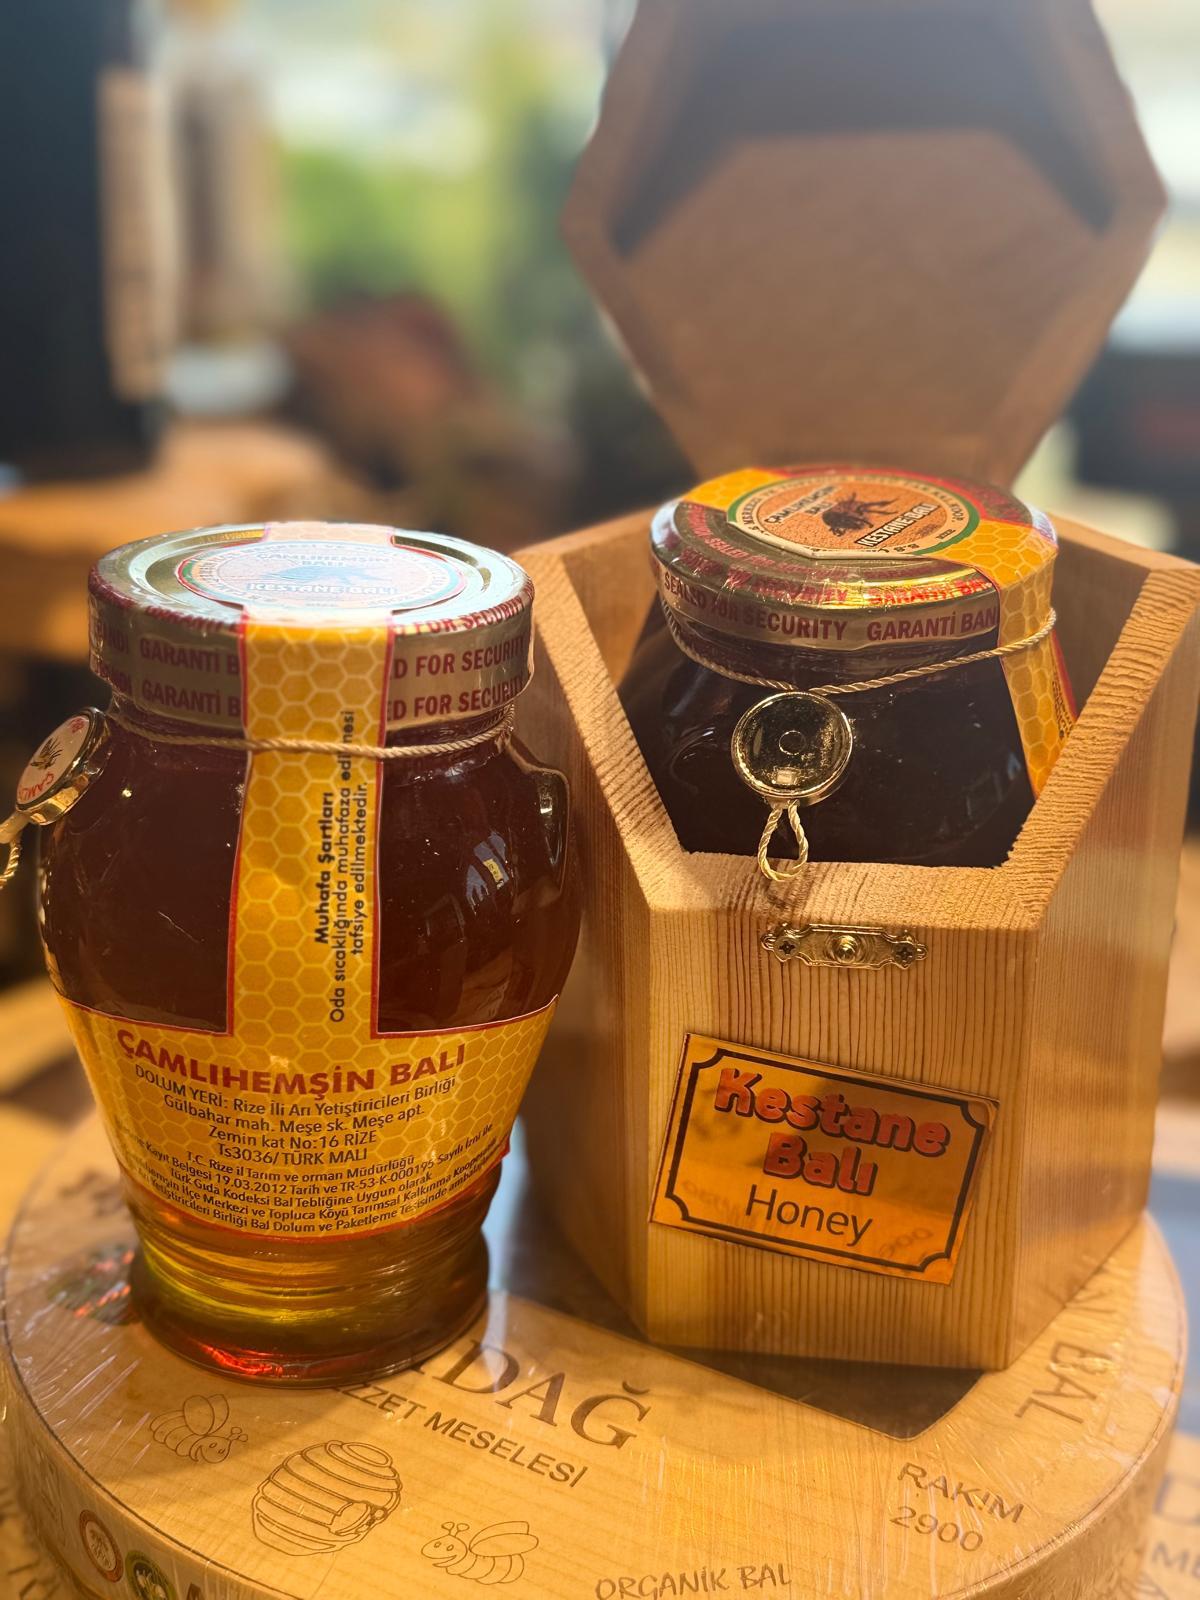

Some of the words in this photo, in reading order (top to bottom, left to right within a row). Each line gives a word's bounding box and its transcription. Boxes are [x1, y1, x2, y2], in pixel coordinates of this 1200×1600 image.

[856, 514, 906, 547] KESTANE
[904, 502, 938, 524] BALI
[249, 582, 344, 595] KESTANE
[743, 605, 848, 642] SECURITY
[866, 610, 957, 641] GARANTİ
[139, 637, 221, 674] GARANTİ
[227, 653, 240, 676] B
[415, 652, 456, 678] FOR
[141, 679, 222, 716] GARANTİ
[227, 695, 240, 718] B
[413, 693, 453, 718] FOR
[317, 792, 335, 865] Şartları
[334, 787, 352, 874] muhafaza
[350, 782, 368, 894] edilmektedir.
[314, 871, 331, 945] Muhafa
[348, 900, 368, 955] tafsiye
[331, 880, 350, 982] sıcaklığında
[329, 987, 345, 1023] Oda
[116, 1029, 375, 1101] ÇAMLIHEMŞİN
[390, 1043, 466, 1087] BALI
[135, 1064, 187, 1097] DOLUM
[189, 1085, 228, 1109] YERİ:
[233, 1098, 266, 1115] Rize
[289, 1103, 311, 1116] Arı
[315, 1090, 410, 1117] Yetiştiricileri
[414, 1075, 457, 1101] Birliği
[163, 1093, 232, 1126] Gülbahar
[235, 1117, 275, 1132] mah.
[279, 1119, 323, 1136] Meşe
[326, 1117, 349, 1132] sk.
[352, 1113, 394, 1129] Meşe
[397, 1103, 425, 1122] apt.
[713, 1066, 951, 1158] Kestane
[208, 1124, 257, 1146] Zemin
[261, 1134, 286, 1149] kat
[289, 1135, 339, 1150] No:16
[344, 1129, 378, 1147] RİZE
[329, 1147, 368, 1165] MALI
[172, 1156, 212, 1181] Belgesi
[215, 1173, 287, 1195] 19.03.2012
[289, 1184, 320, 1195] Tarih
[323, 1183, 338, 1194] ve
[340, 1159, 435, 1193] TR-53-K-000195
[208, 1158, 234, 1175] Rize
[247, 1167, 281, 1182] Tarım
[284, 1173, 299, 1183] ve
[302, 1171, 343, 1183] orman
[346, 1154, 415, 1179] Müdürlüğü
[762, 1131, 879, 1197] Balı
[193, 1178, 220, 1196] Gıda
[223, 1184, 270, 1206] Kodeksi
[273, 1196, 293, 1208] Bal
[295, 1195, 354, 1209] Tebliğine
[356, 1187, 396, 1203] Uygun
[398, 1171, 433, 1192] olarak
[202, 1193, 249, 1215] Merkezi
[251, 1208, 266, 1218] ve
[268, 1207, 316, 1222] Topluca
[212, 1208, 248, 1228] Birliği
[251, 1218, 270, 1231] Bal
[272, 1221, 316, 1233] Dolum
[318, 1222, 333, 1232] ve
[335, 1210, 398, 1230] Paketleme
[744, 1183, 874, 1247] Honey
[410, 1338, 652, 1451] DAĞ
[889, 1504, 985, 1553] 2900
[594, 1565, 731, 1600] ORGANİK
[738, 1562, 793, 1590] BAL
